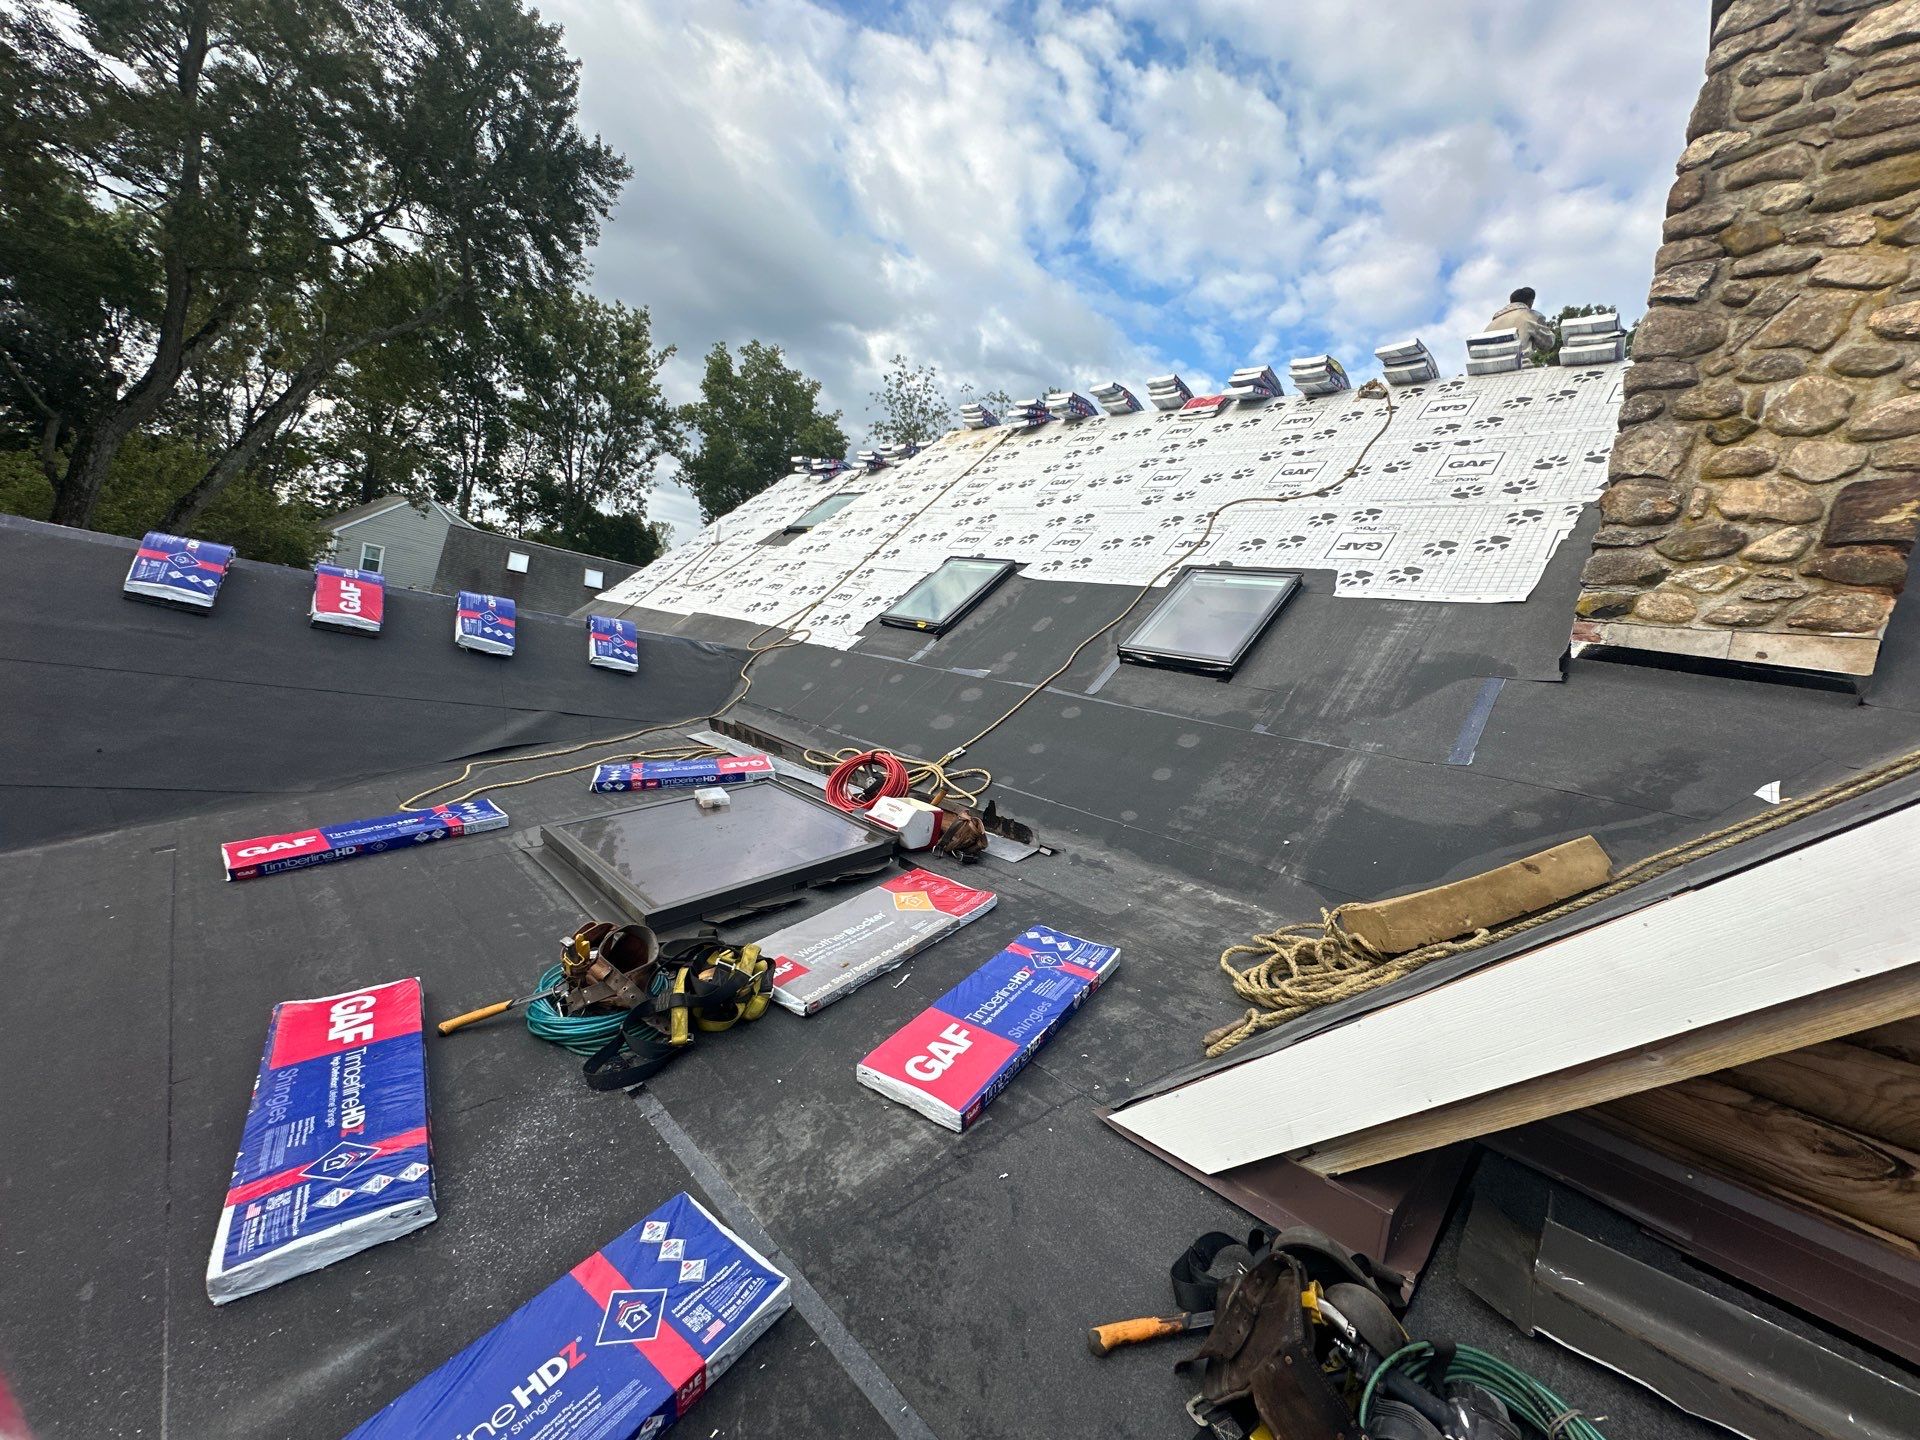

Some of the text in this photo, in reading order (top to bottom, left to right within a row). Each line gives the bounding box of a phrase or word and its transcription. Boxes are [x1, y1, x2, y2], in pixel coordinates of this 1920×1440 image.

[1427, 404, 1468, 413] GAF
[1281, 417, 1314, 425] GAF
[1280, 468, 1318, 476] GAF
[1448, 460, 1495, 468] GAF
[1152, 474, 1182, 482] GAF
[1052, 538, 1081, 546] GAF
[1336, 542, 1383, 550] GAF
[339, 580, 361, 613] GAF
[722, 760, 765, 769] GAF
[237, 836, 316, 857] GAF
[795, 911, 886, 958] WeatherBlocker
[328, 995, 377, 1044] GAF
[1008, 1001, 1052, 1038] Shingles
[904, 1023, 974, 1082] GAF
[266, 1067, 302, 1124] Shingles
[721, 1303, 737, 1318] MADE
[740, 1289, 750, 1299] THE
[633, 1314, 641, 1322] 4
[681, 1372, 702, 1401] NE
[511, 1389, 563, 1435] Shingles
[554, 1411, 571, 1427] Algae
[568, 1405, 588, 1424] Nailing
[587, 1394, 601, 1407] Area
[571, 1402, 602, 1429] Technology
